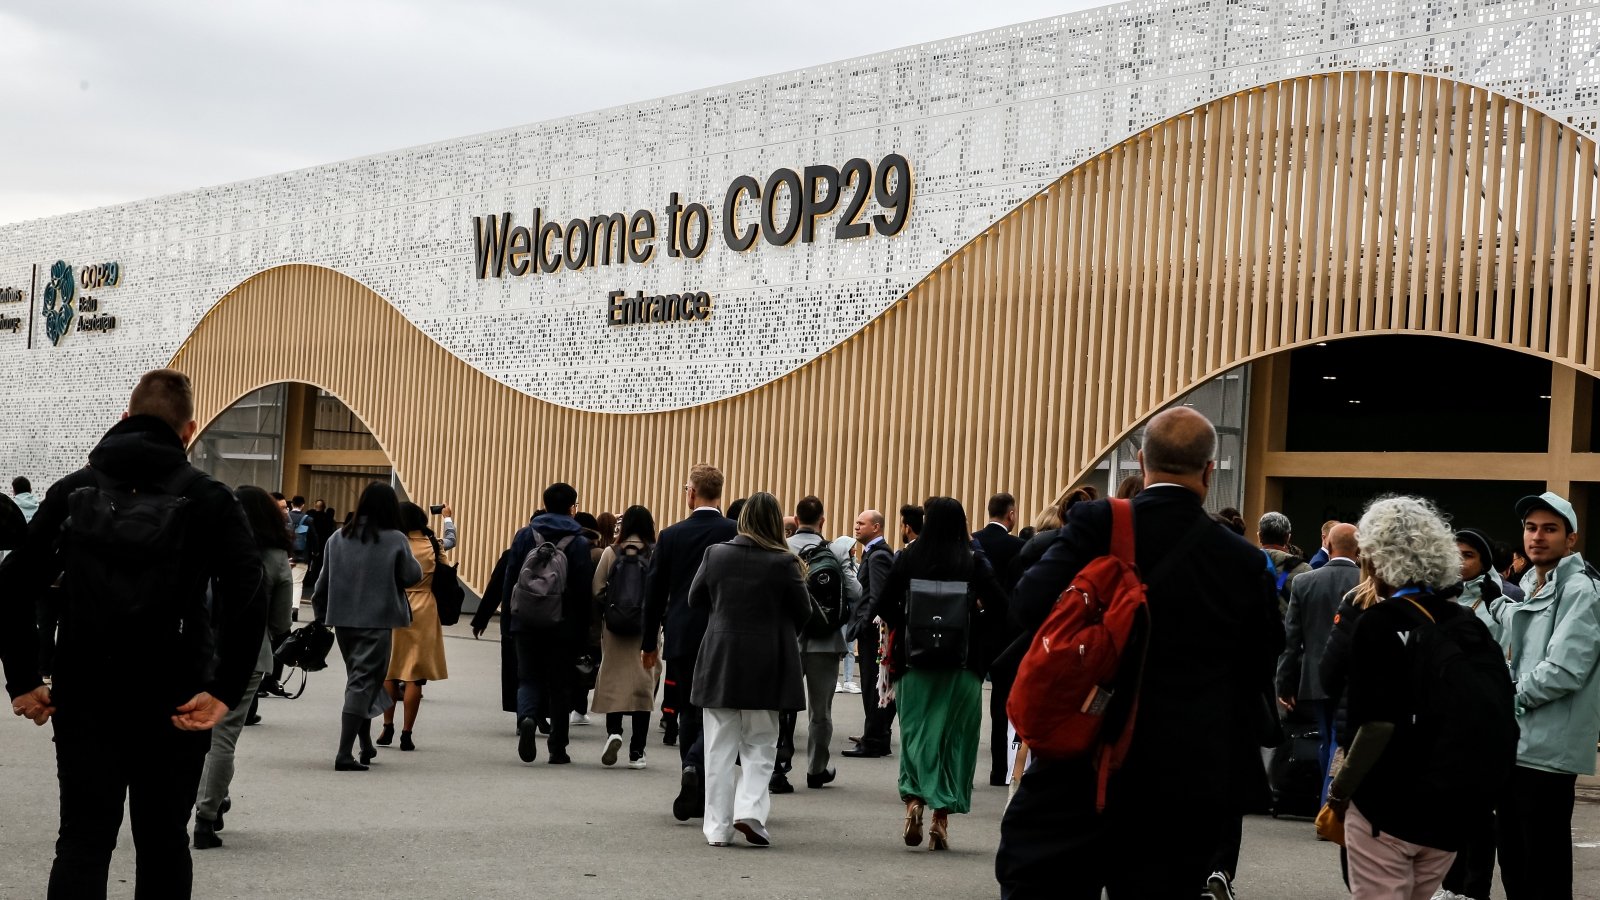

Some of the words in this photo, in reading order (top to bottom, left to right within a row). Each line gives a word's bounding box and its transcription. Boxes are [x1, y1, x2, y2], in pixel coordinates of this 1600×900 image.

[473, 207, 655, 279] Welcome
[665, 191, 709, 259] to
[723, 153, 912, 252] COP29
[80, 260, 119, 289] COP29
[608, 290, 711, 326] Entrance
